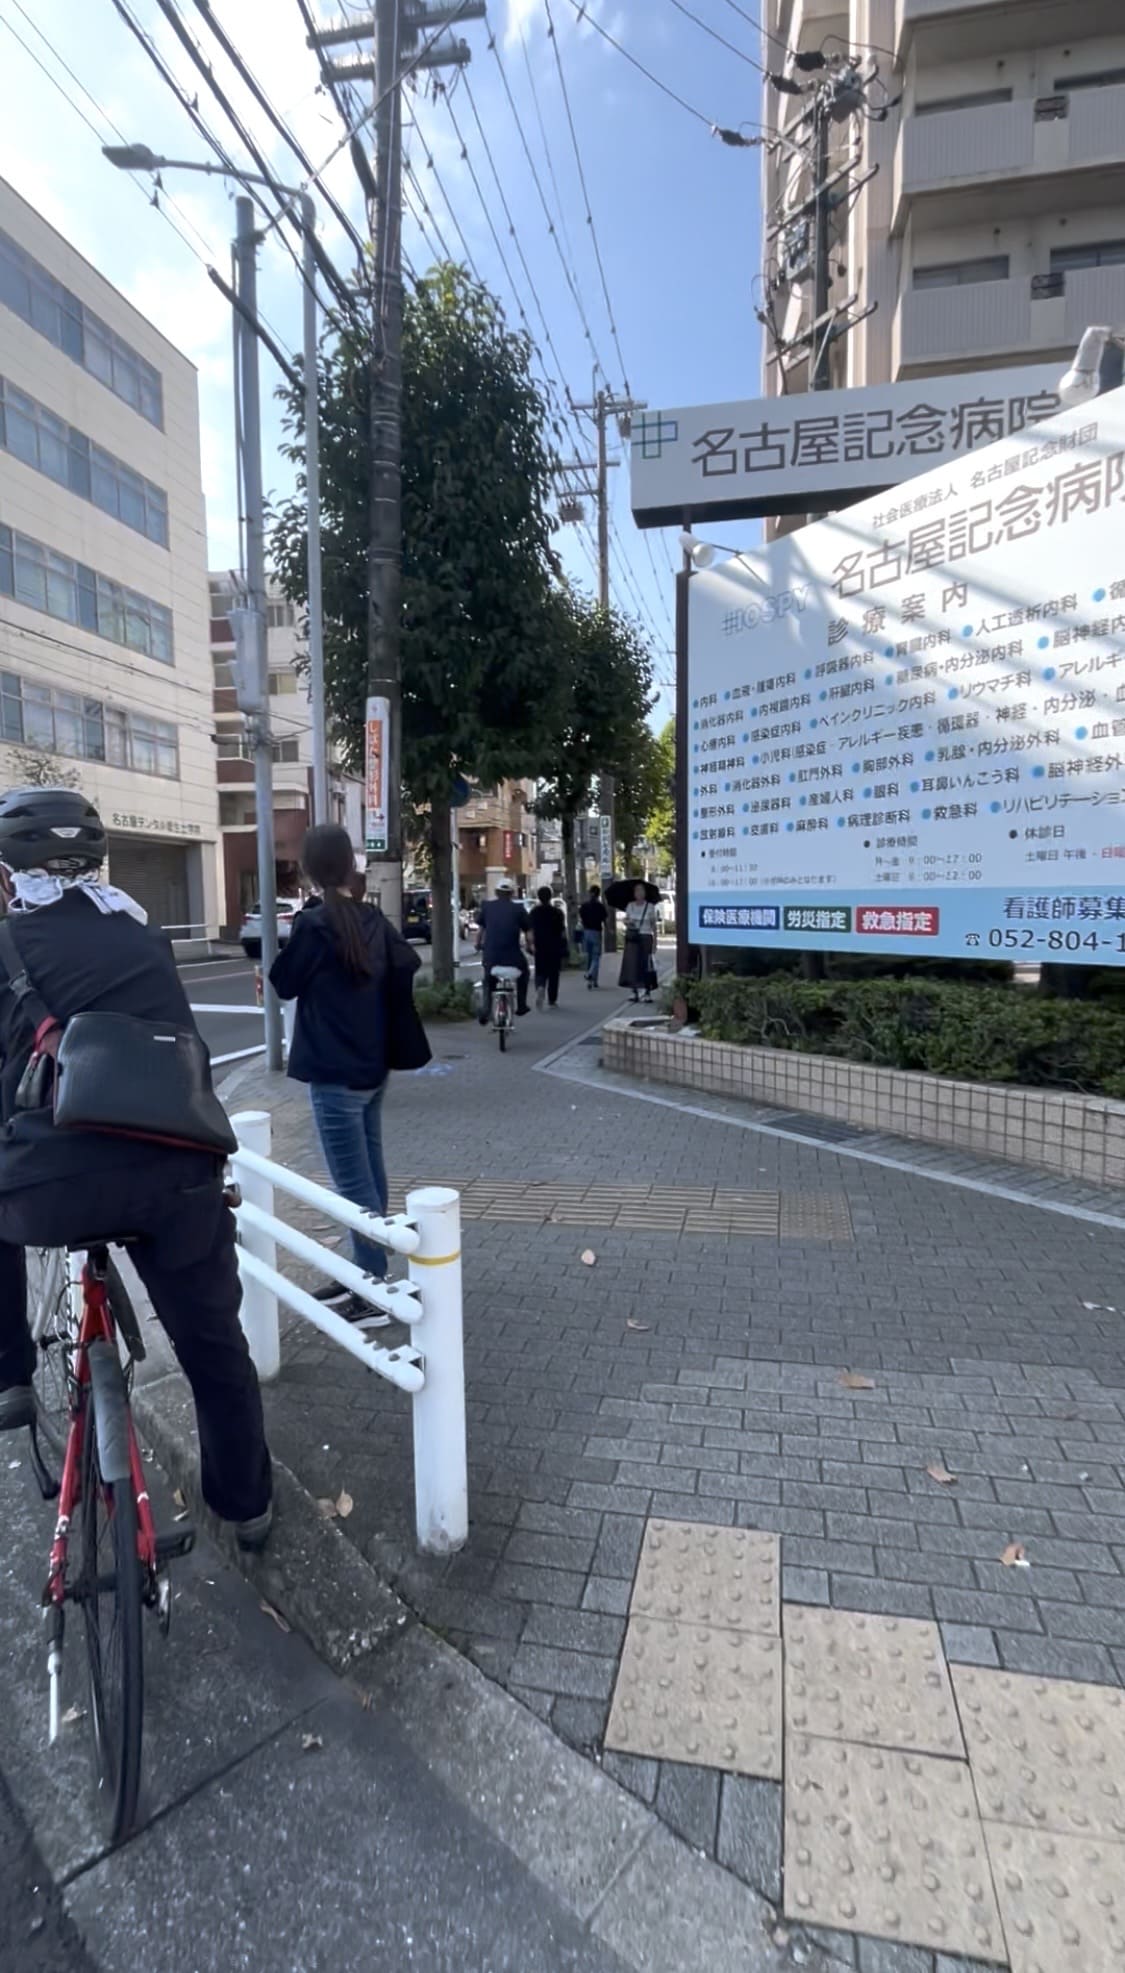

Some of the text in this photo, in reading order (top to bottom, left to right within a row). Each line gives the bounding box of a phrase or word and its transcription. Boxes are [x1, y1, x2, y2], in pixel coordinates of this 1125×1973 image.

[691, 389, 1061, 477] 名古屋記念病院
[872, 422, 1098, 529] 社会医療法人 名古屋記念財団
[827, 581, 968, 647] 診療案内
[700, 694, 717, 708] 内科
[815, 651, 874, 678] 呼吸器内科
[976, 593, 1078, 636] 人工透析内科
[700, 710, 744, 730] 消化器内科
[751, 721, 801, 742] 感染症内科
[960, 670, 1031, 699] リウマチ科
[700, 784, 717, 797] 外科
[797, 764, 843, 783] 肛門外科
[862, 752, 914, 774] 胸部外科
[874, 782, 899, 799] 眼科
[922, 766, 1019, 792] 耳鼻いんこう科
[847, 809, 911, 827] 病理診断科
[934, 802, 978, 821] 救急科
[787, 909, 846, 929] 労災指定
[862, 911, 932, 931] 救急指定
